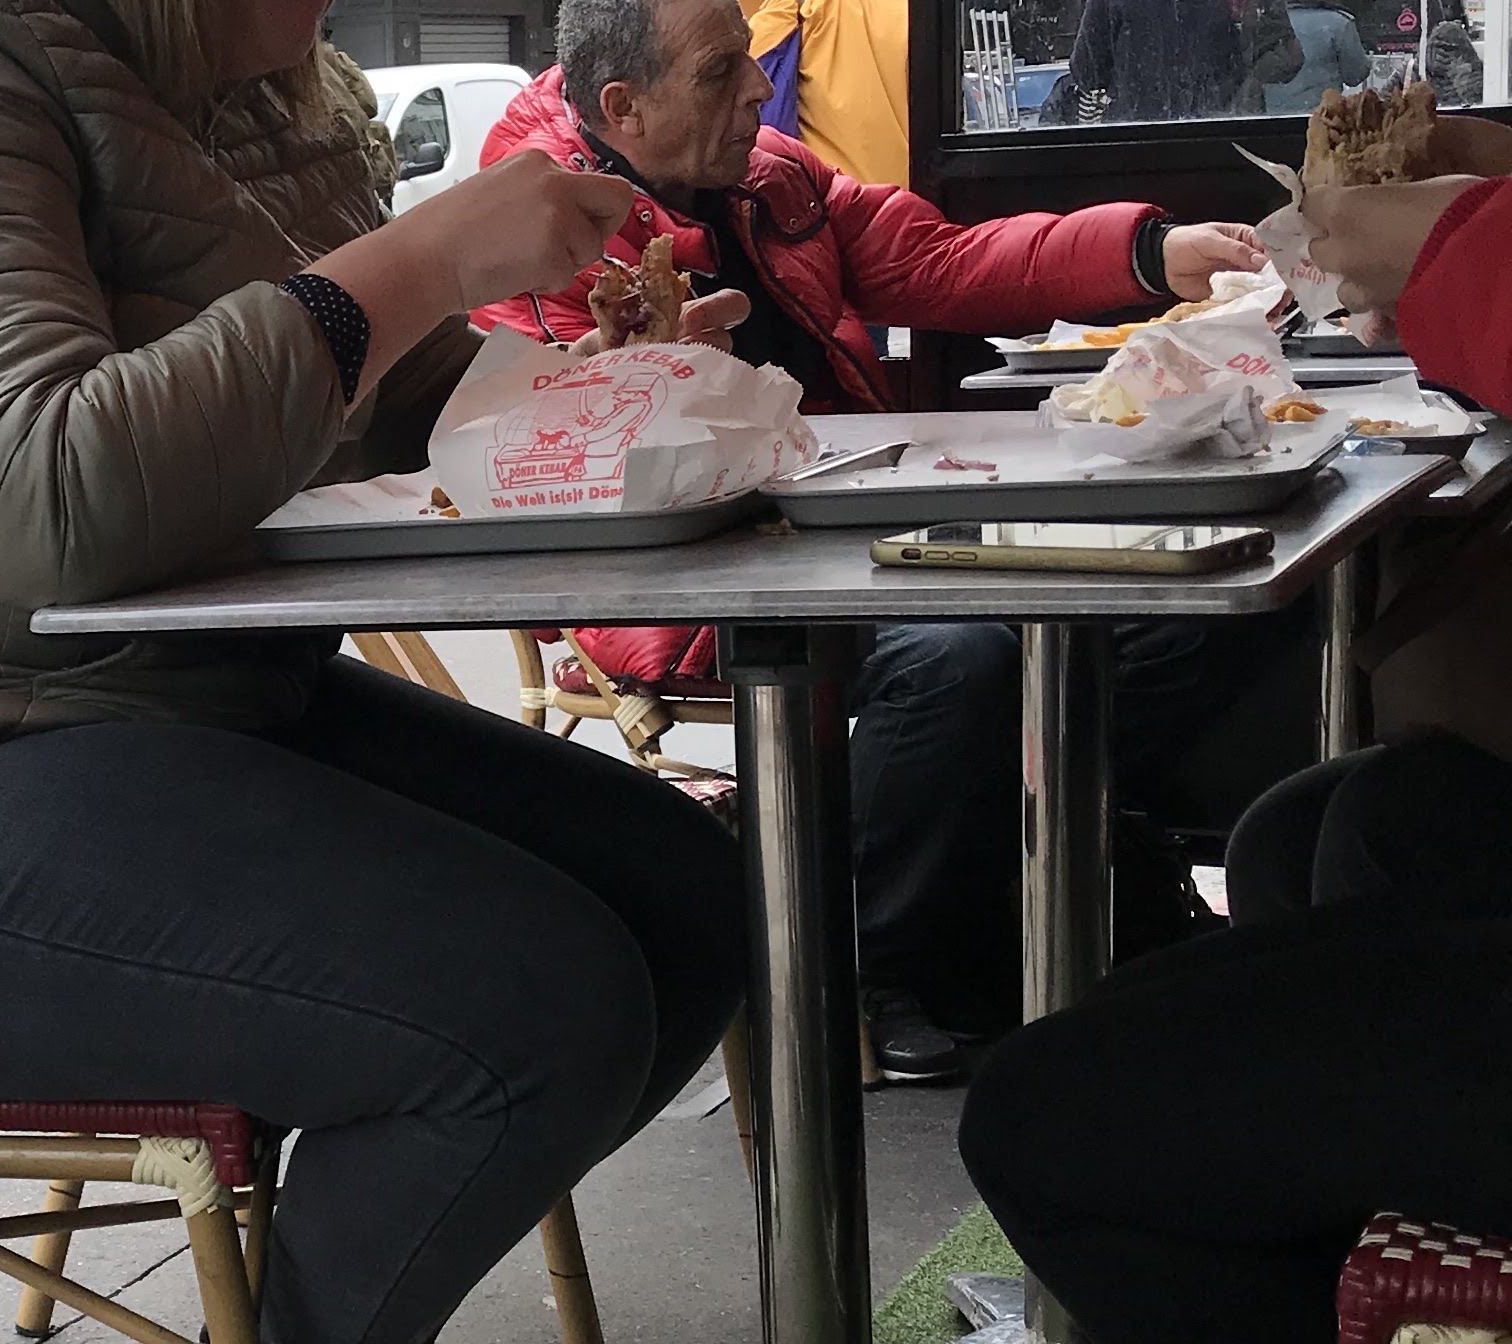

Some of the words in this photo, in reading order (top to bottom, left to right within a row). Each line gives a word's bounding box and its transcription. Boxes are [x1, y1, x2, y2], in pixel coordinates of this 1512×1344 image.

[533, 353, 624, 391] DÖNER
[624, 350, 696, 380] KEBAB
[491, 496, 513, 509] Die
[516, 492, 546, 507] Welt
